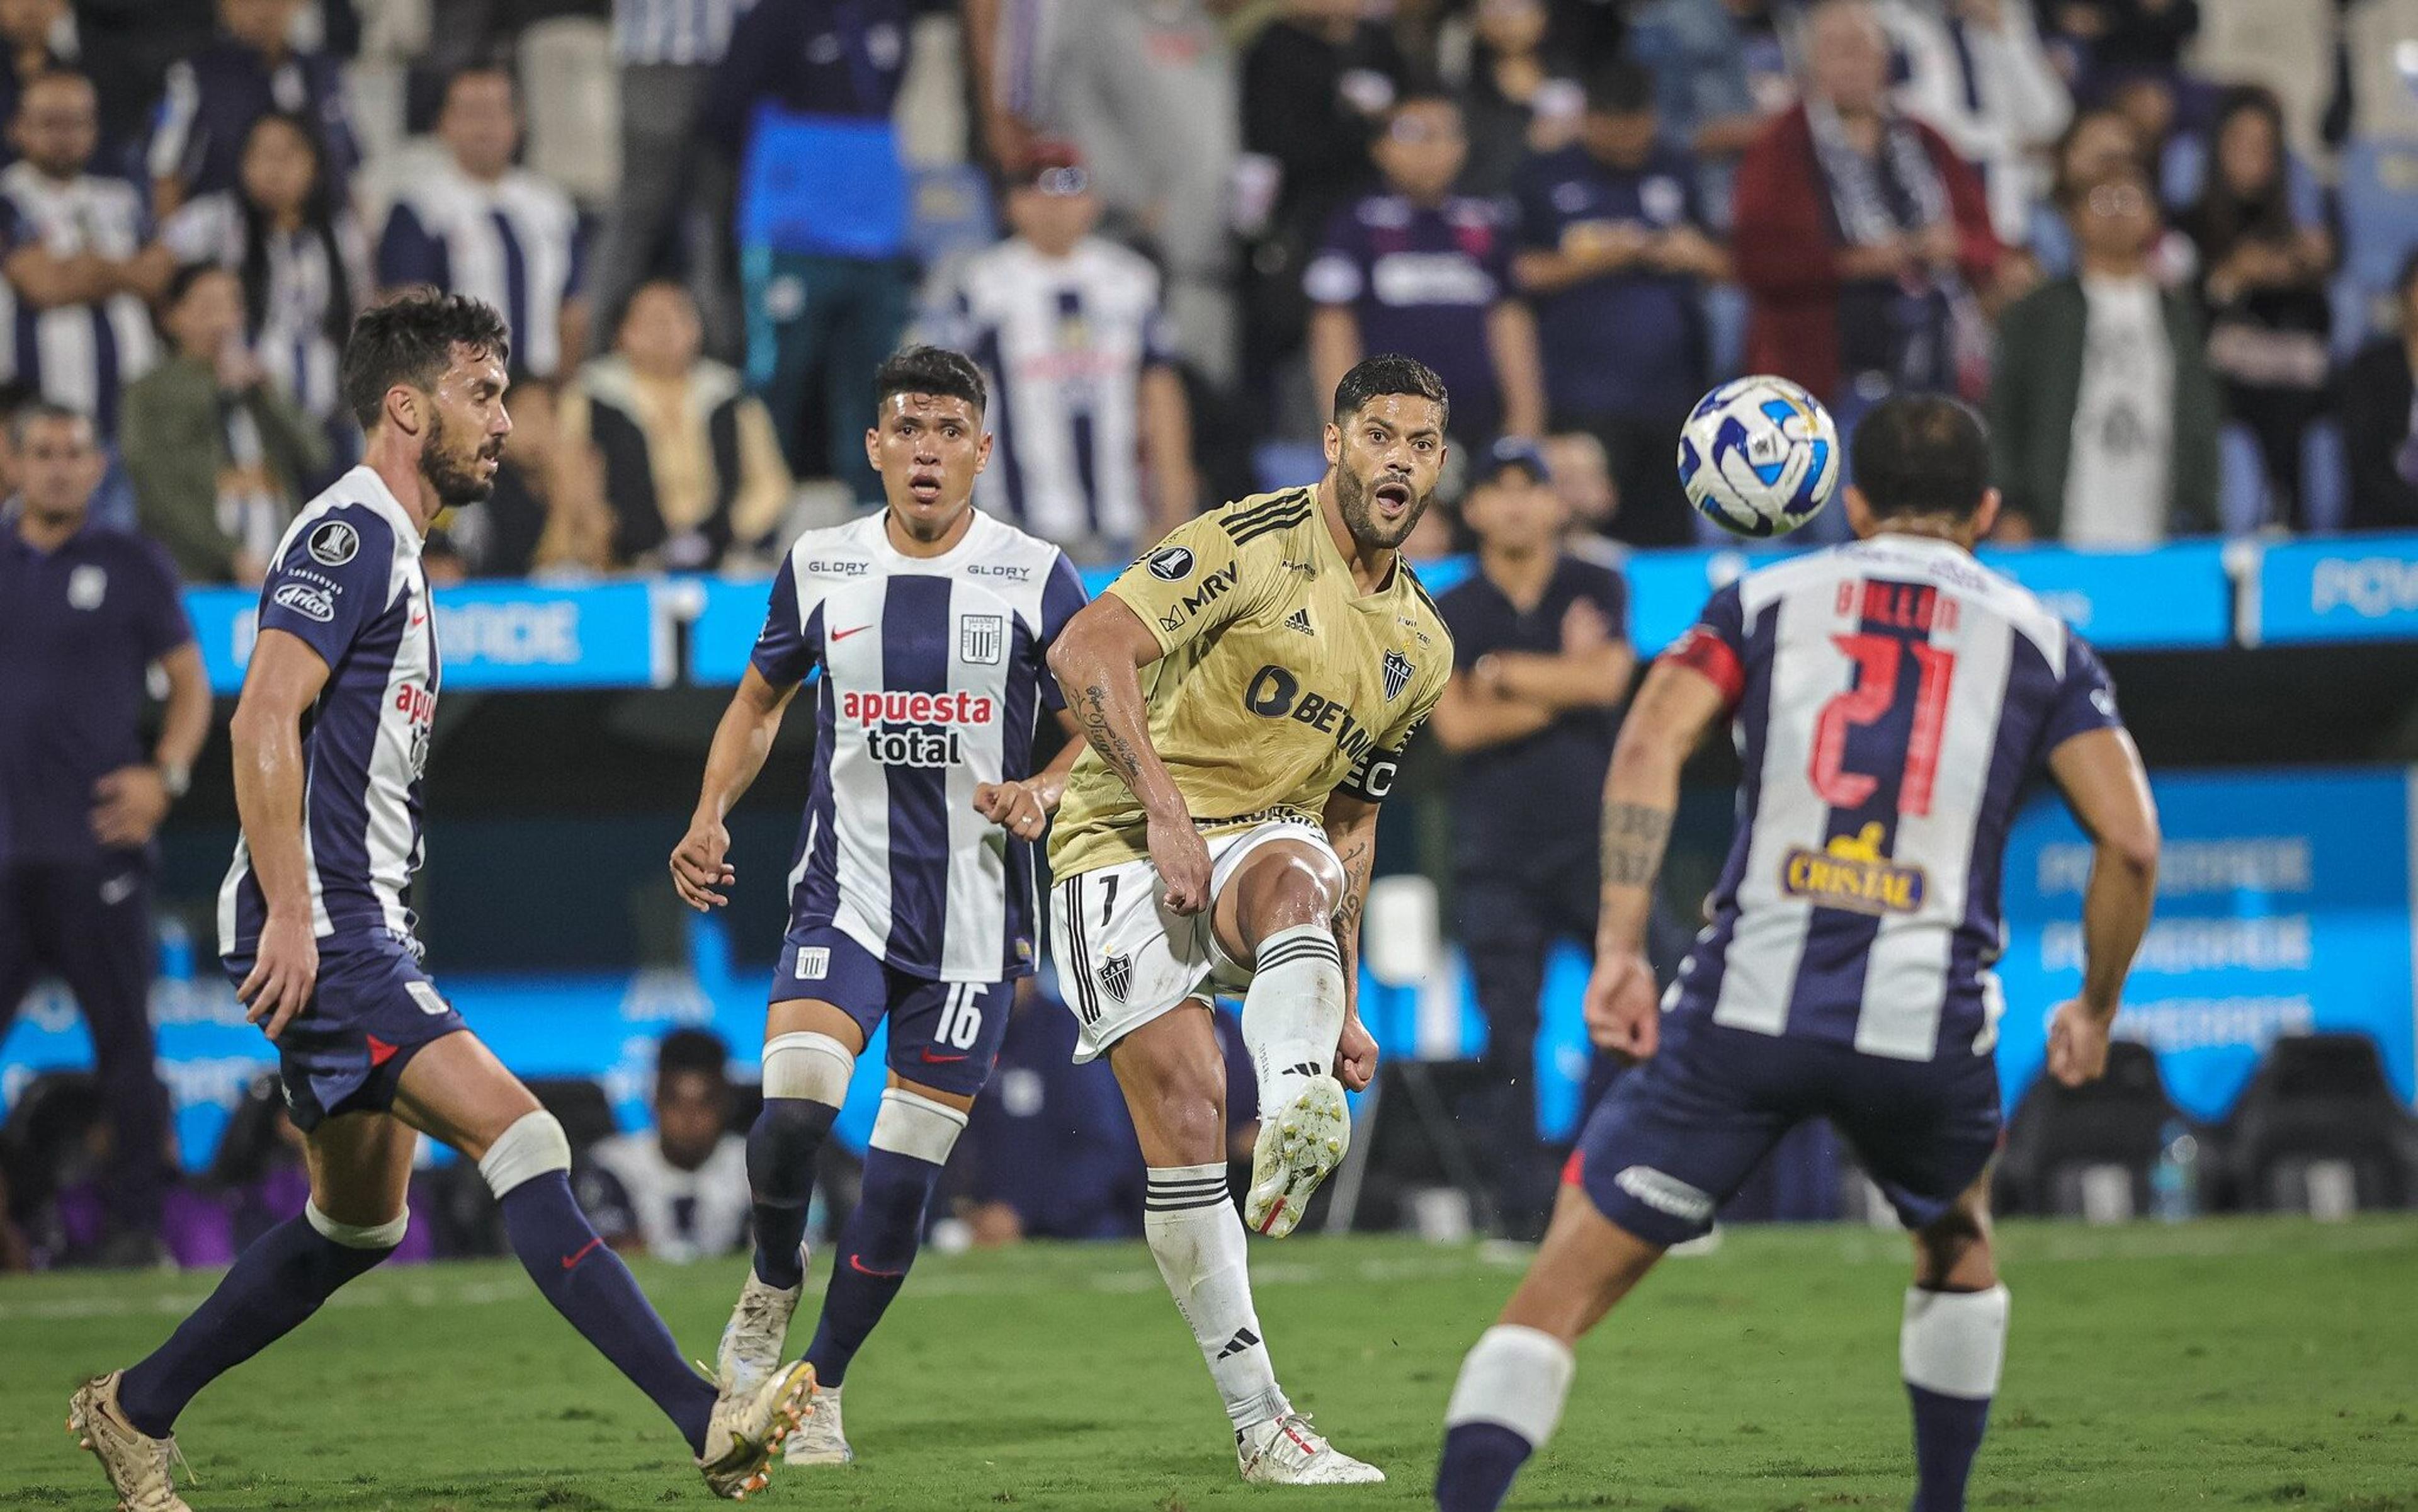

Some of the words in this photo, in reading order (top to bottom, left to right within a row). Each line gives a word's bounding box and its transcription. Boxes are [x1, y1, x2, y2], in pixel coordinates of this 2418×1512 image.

[809, 561, 869, 572] GLORY
[967, 565, 1030, 577] GLORY
[1183, 560, 1238, 617] MRV
[1285, 620, 1314, 636] adidas
[1387, 657, 1409, 676] CAM
[844, 691, 991, 727] apuesta
[1807, 634, 1956, 819] 21
[867, 729, 962, 764] total
[1099, 874, 1120, 927] 7
[1103, 960, 1125, 977] CAM
[934, 982, 989, 1050] 16
